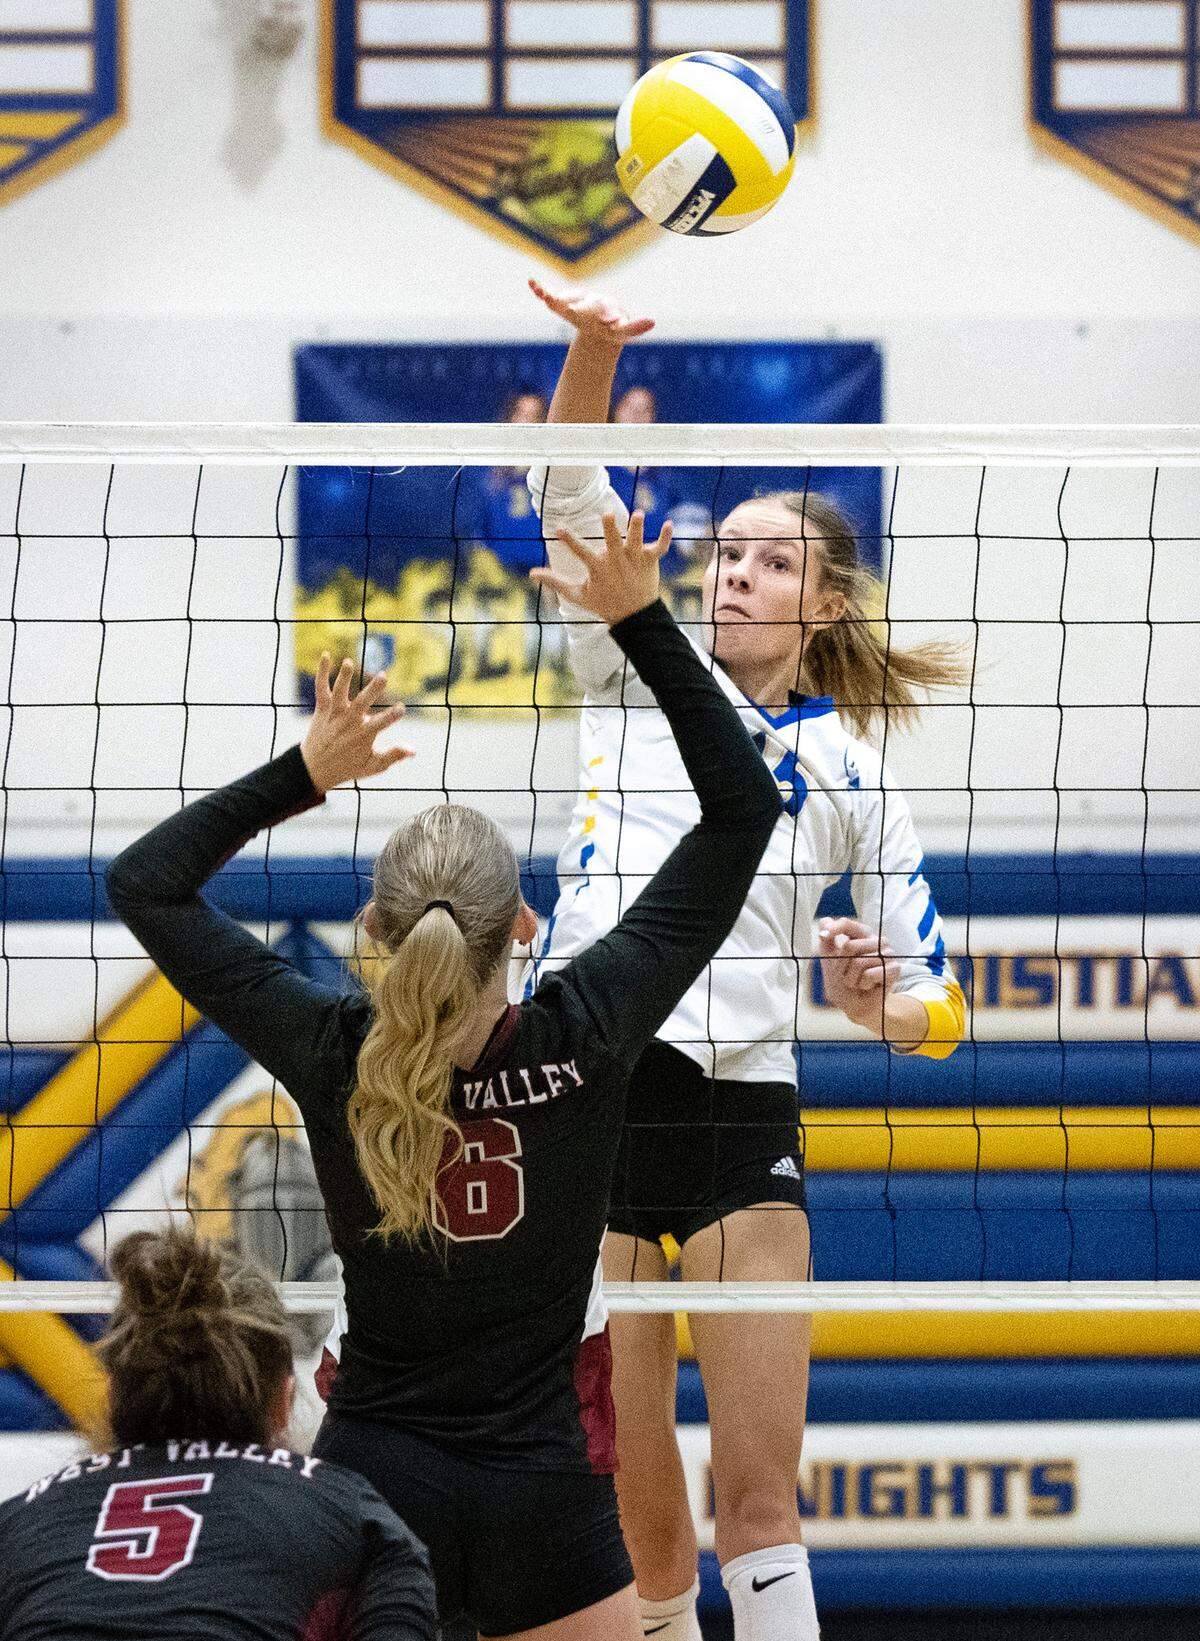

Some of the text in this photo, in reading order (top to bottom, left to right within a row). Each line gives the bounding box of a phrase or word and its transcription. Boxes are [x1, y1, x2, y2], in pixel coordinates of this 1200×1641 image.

[808, 950, 1200, 1009] ISTIA
[463, 1059, 584, 1110] VALLEY
[430, 1117, 524, 1242] 6
[166, 1439, 322, 1478] VALLEY
[703, 1460, 1078, 1518] IGHTS
[86, 1472, 214, 1582] 5
